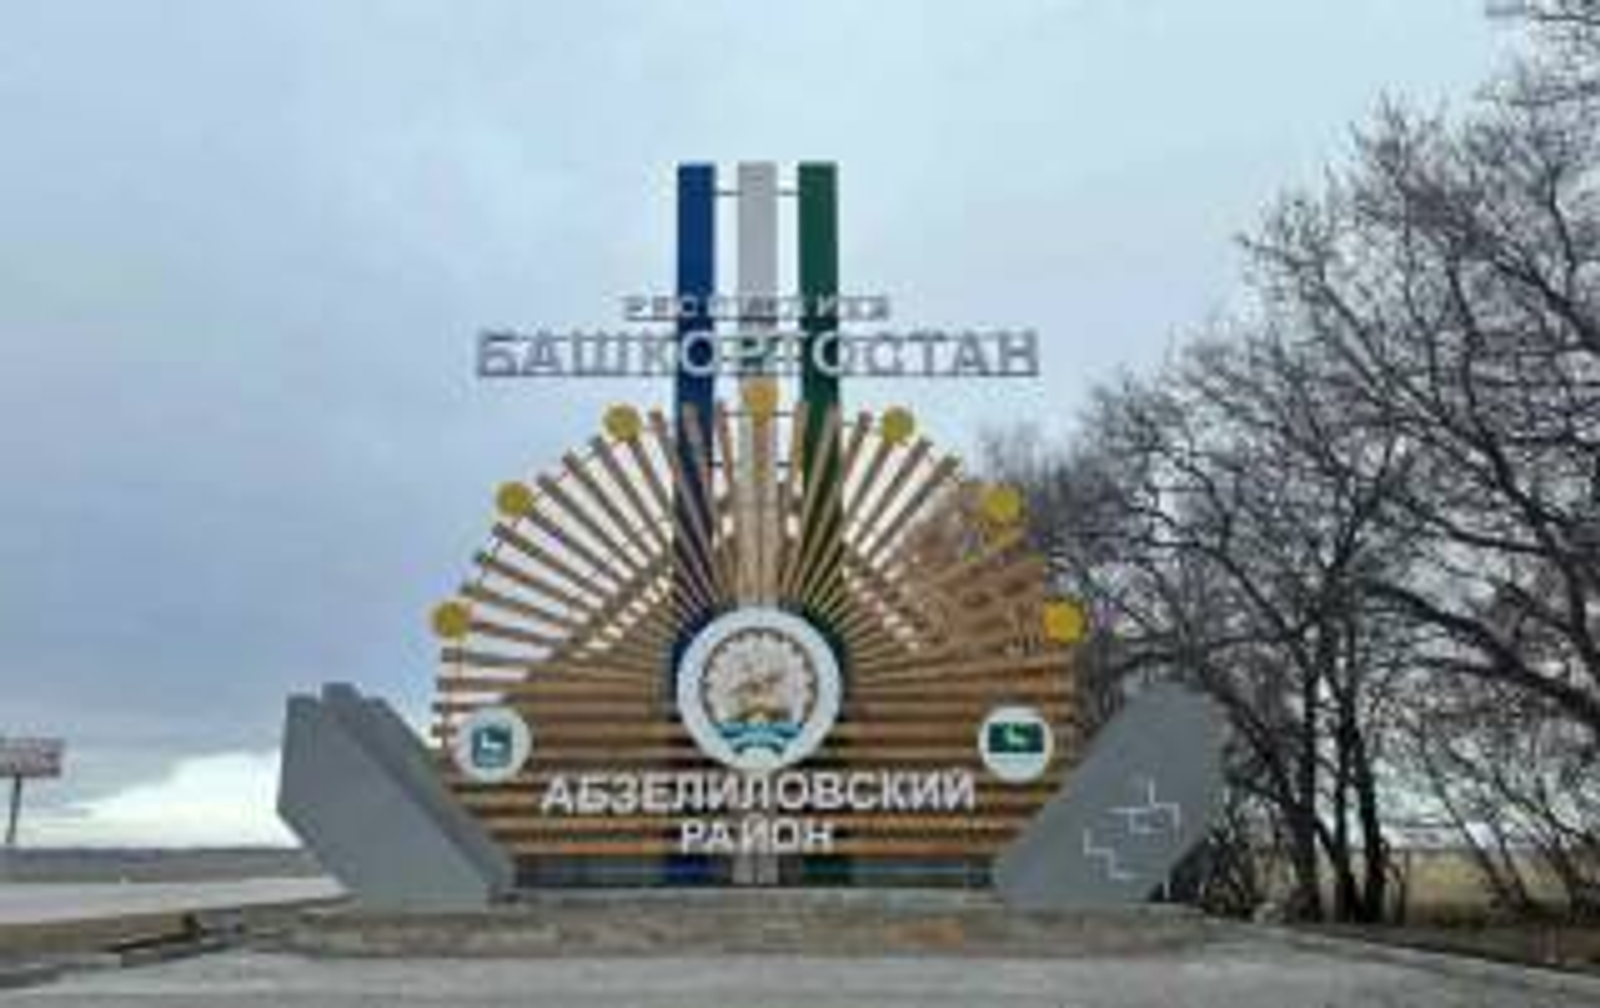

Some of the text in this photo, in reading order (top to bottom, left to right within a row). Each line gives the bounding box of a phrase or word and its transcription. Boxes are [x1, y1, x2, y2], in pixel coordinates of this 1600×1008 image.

[476, 329, 1040, 378] БАШКОРТОСТАН
[541, 771, 976, 814] АБЗЕЛИЛОВСКИЙ
[681, 813, 835, 854] РАЙОН
